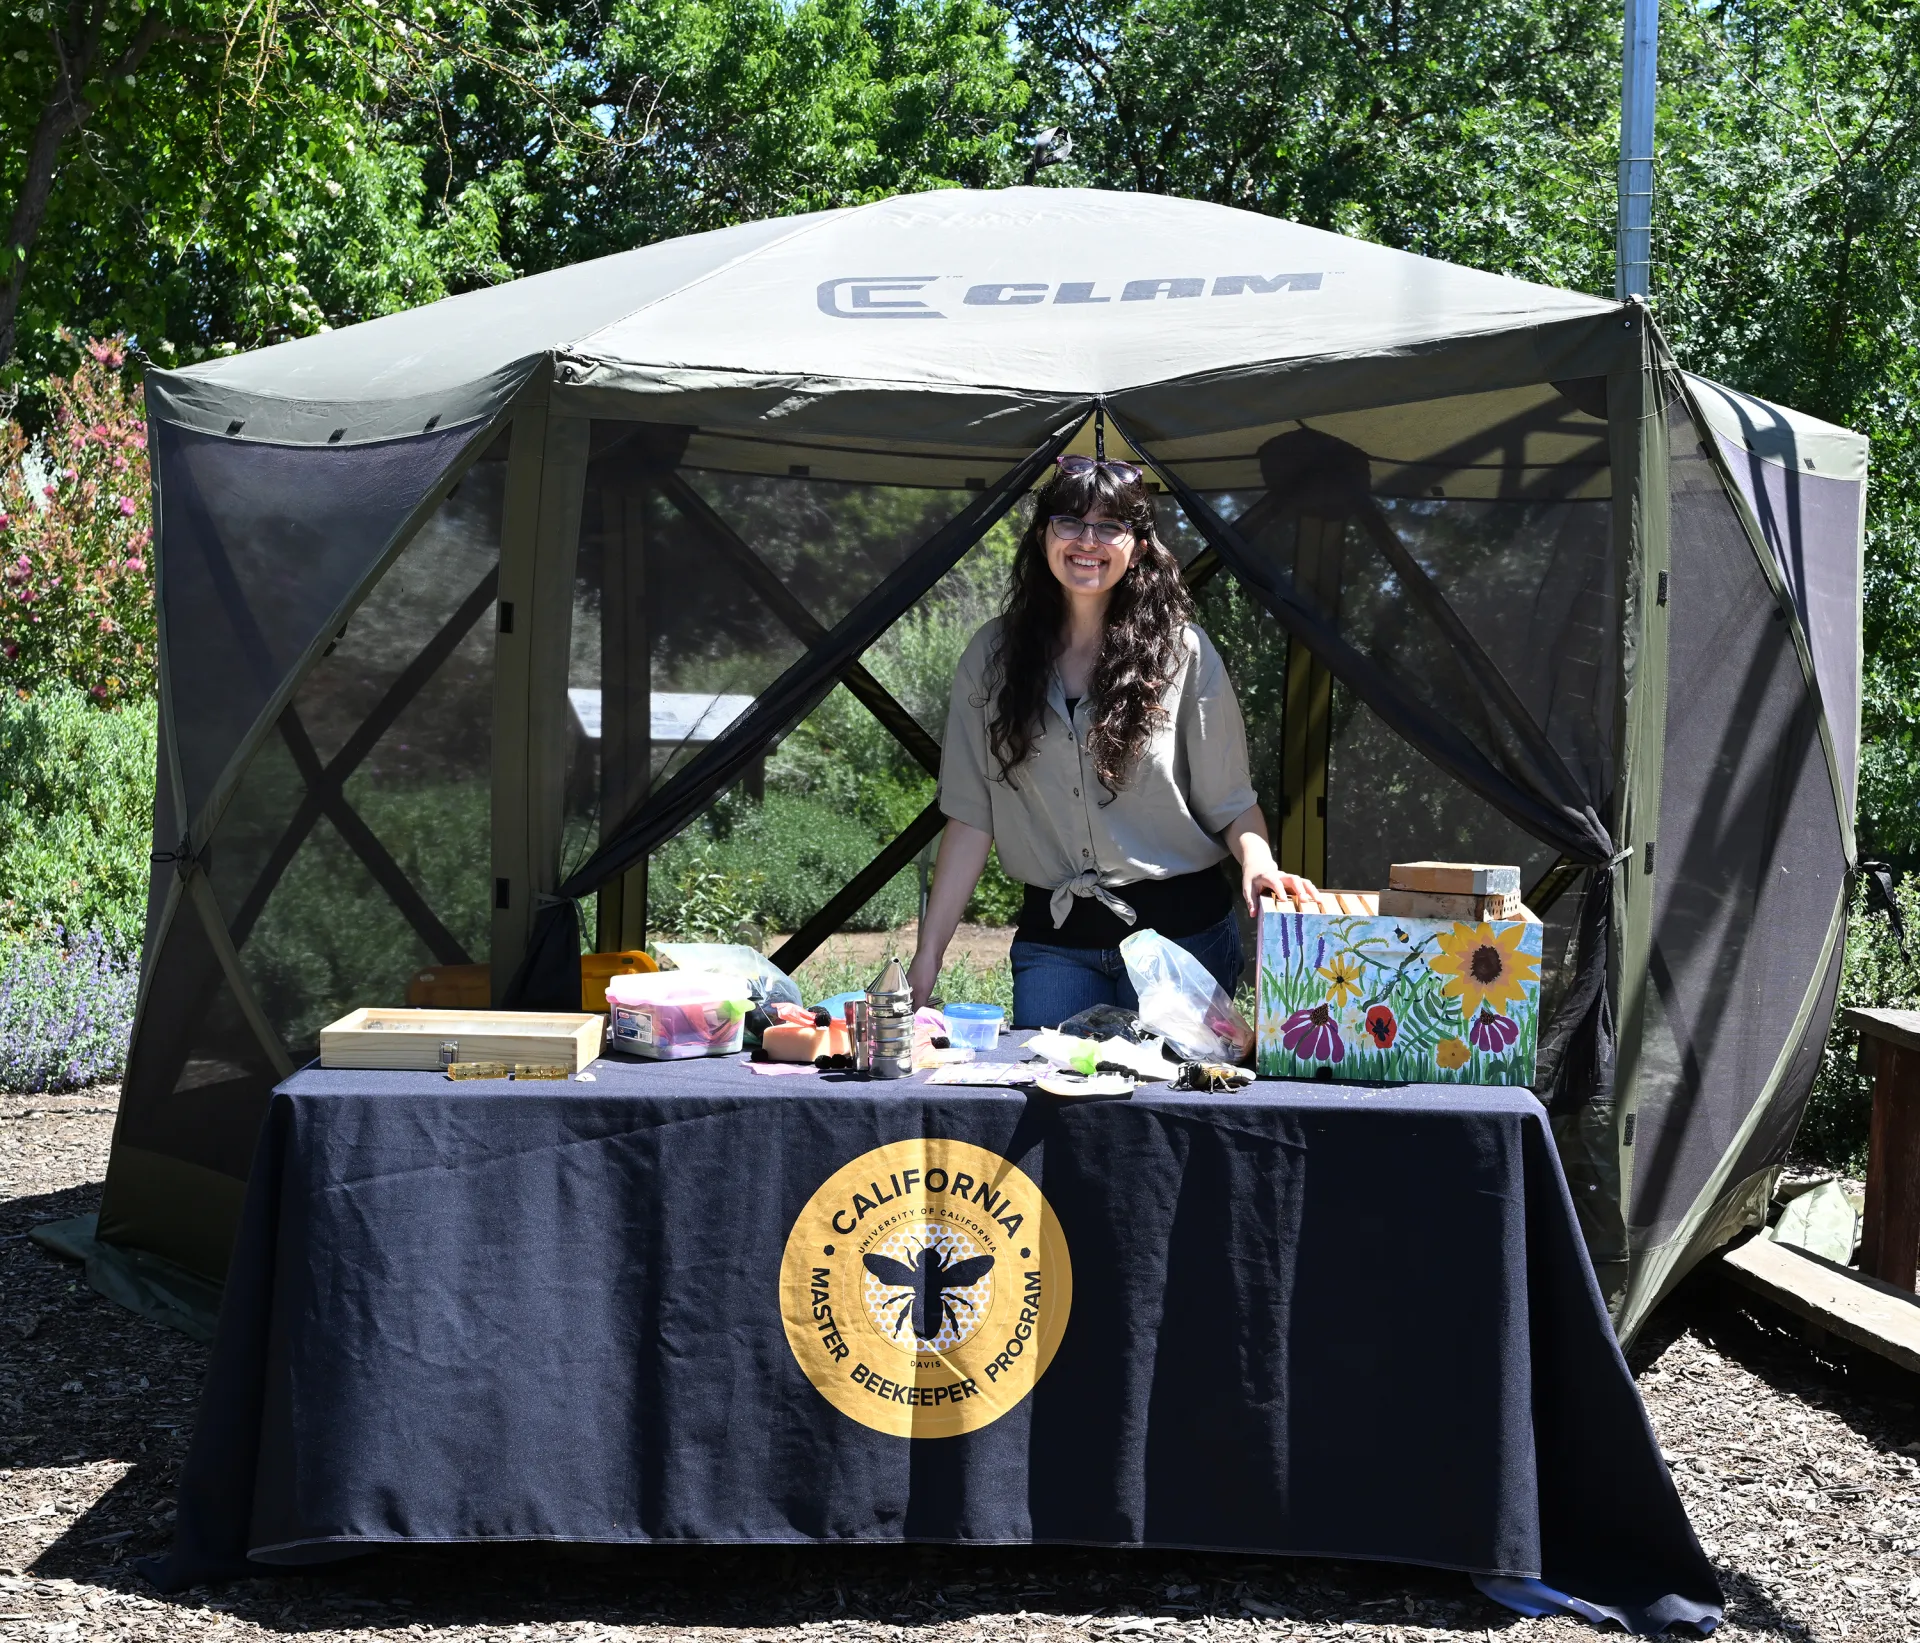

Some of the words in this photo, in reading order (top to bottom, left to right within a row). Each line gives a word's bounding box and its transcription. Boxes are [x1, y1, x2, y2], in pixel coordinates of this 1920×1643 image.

[962, 271, 1324, 306] CLAM
[831, 1168, 1025, 1240] CALIFORNIA
[858, 1209, 916, 1254] UNIVERSITY
[920, 1207, 936, 1215] OF
[940, 1208, 998, 1254] CALIFORNIA
[810, 1267, 850, 1364] MASTER
[849, 1362, 980, 1407] BEEKEEPER
[984, 1270, 1042, 1383] PROGRAM
[910, 1359, 942, 1369] DAVIS
